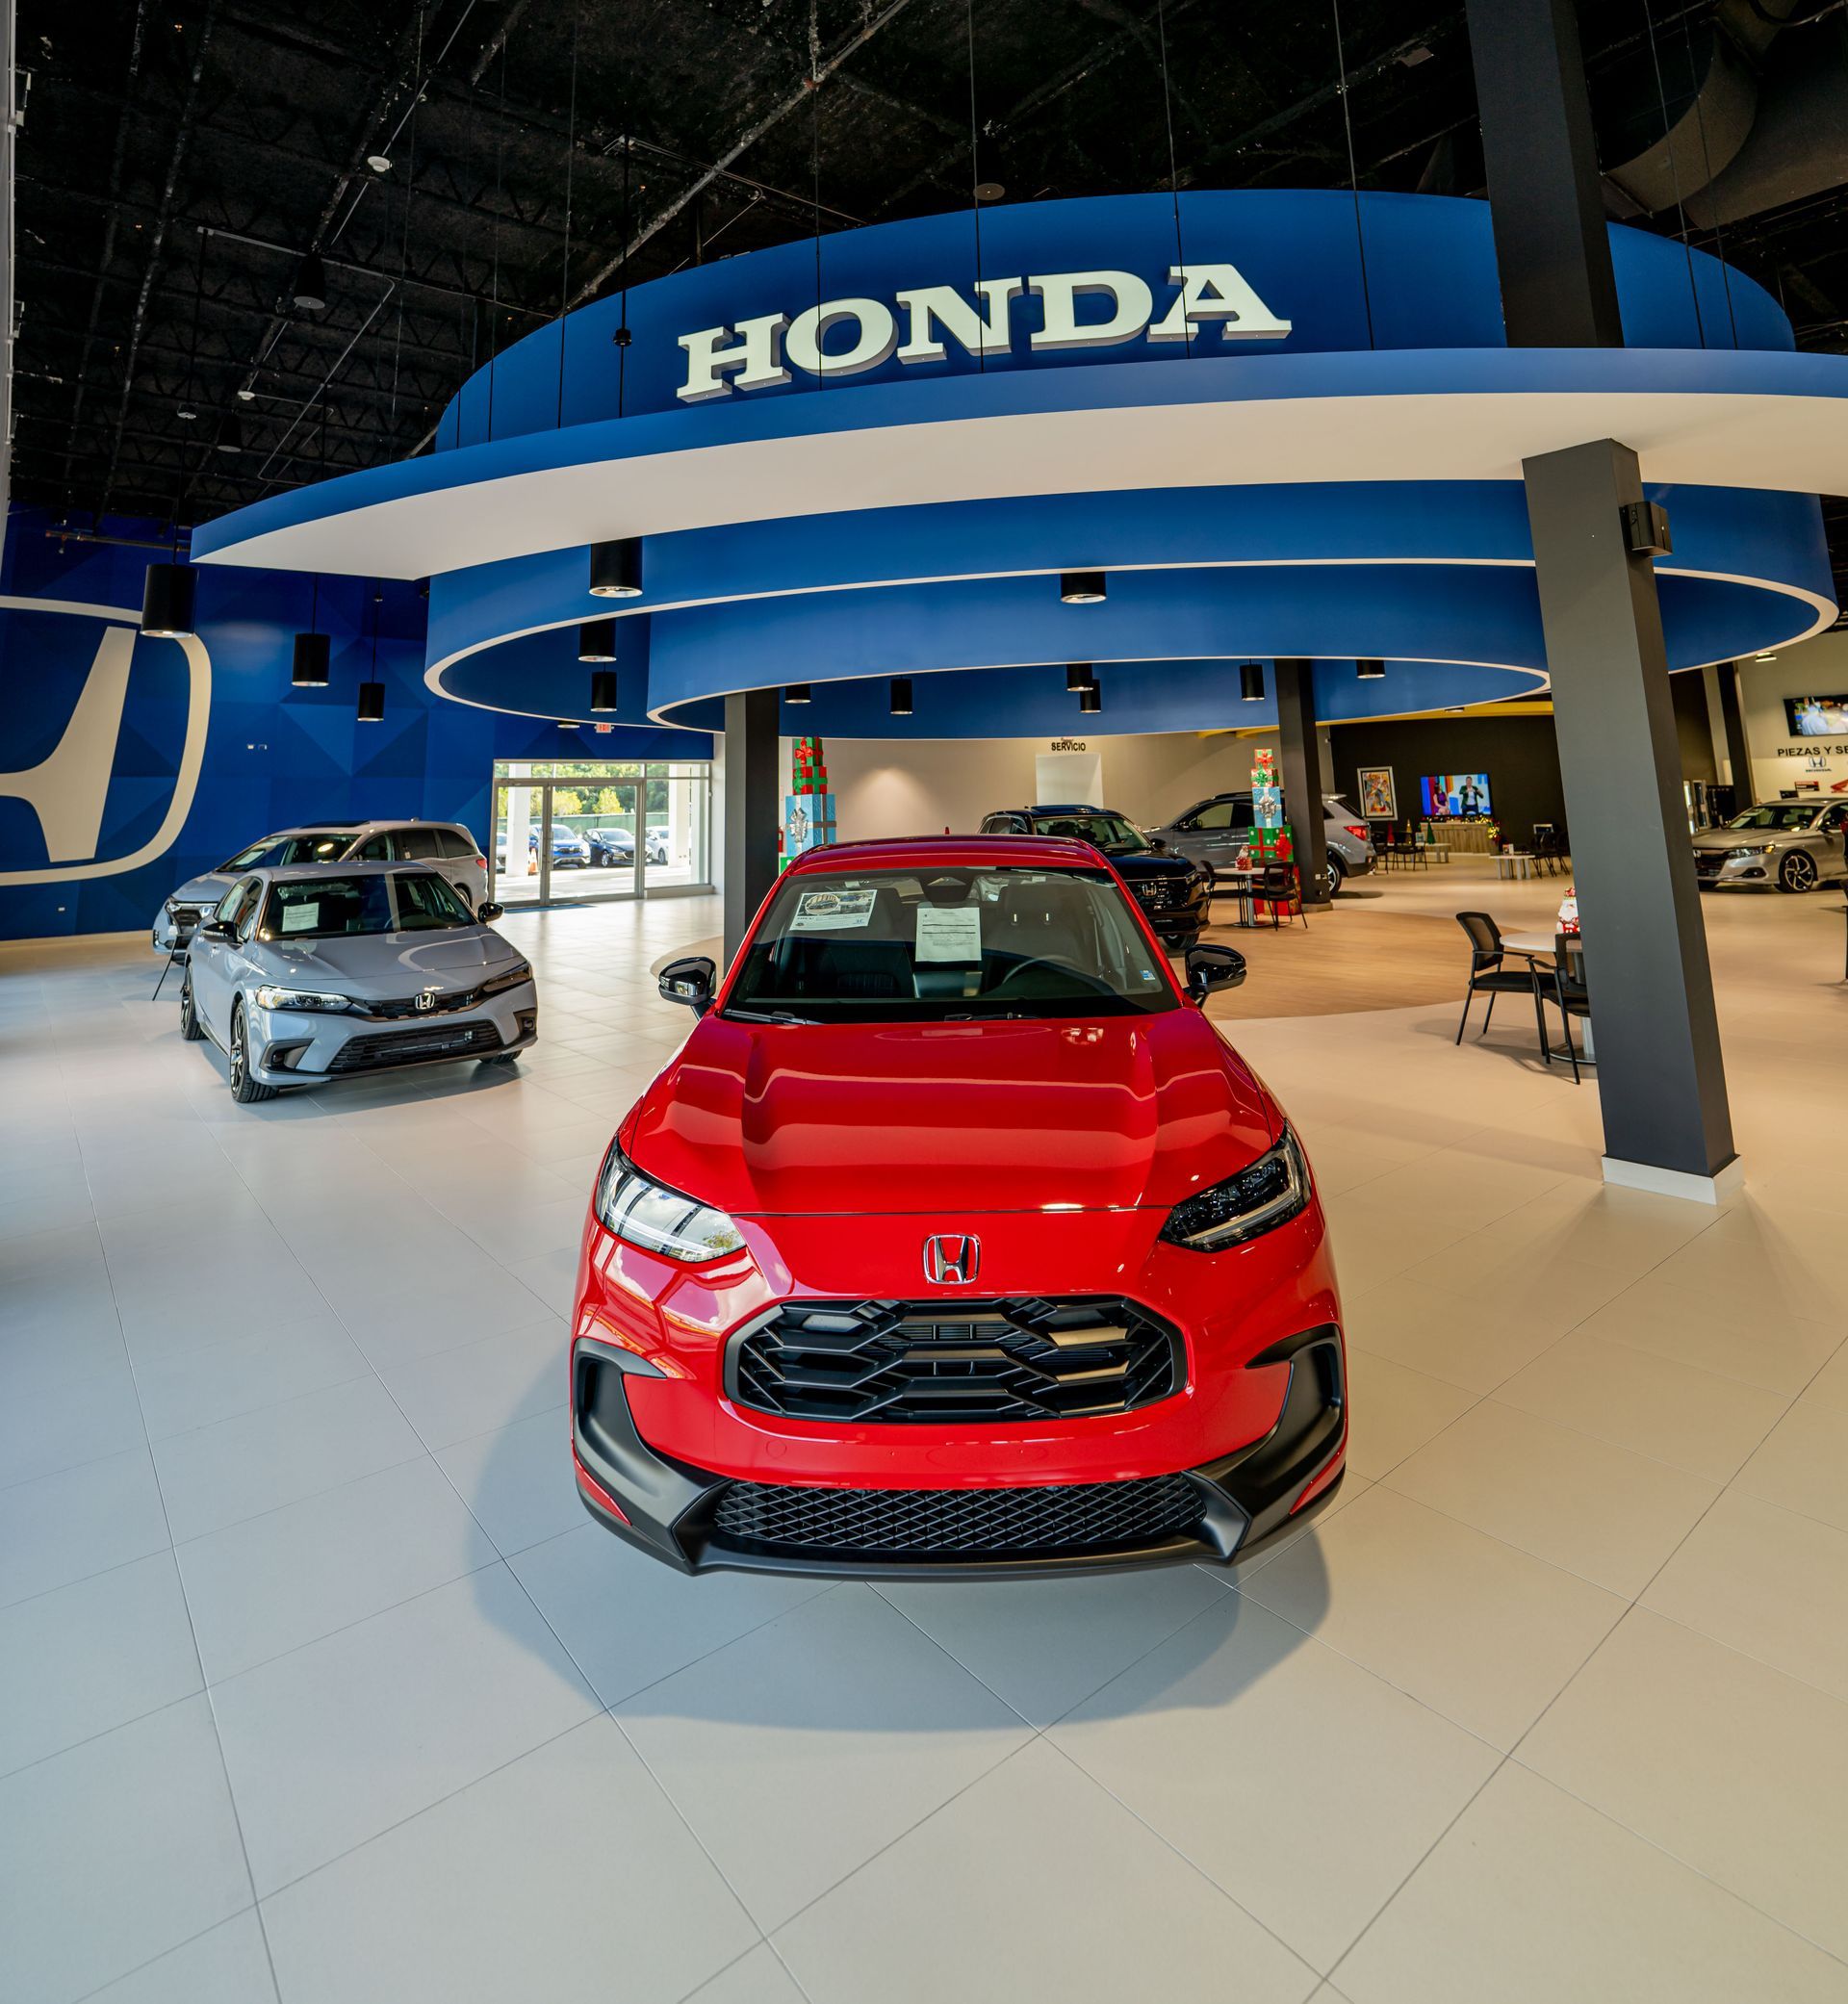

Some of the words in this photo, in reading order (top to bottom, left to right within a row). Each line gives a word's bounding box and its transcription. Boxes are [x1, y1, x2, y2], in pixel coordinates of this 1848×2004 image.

[676, 263, 1293, 402] HONDA
[1051, 742, 1086, 751] SERVICIO
[1778, 747, 1820, 757] PIEZAS
[1823, 746, 1832, 756] Y
